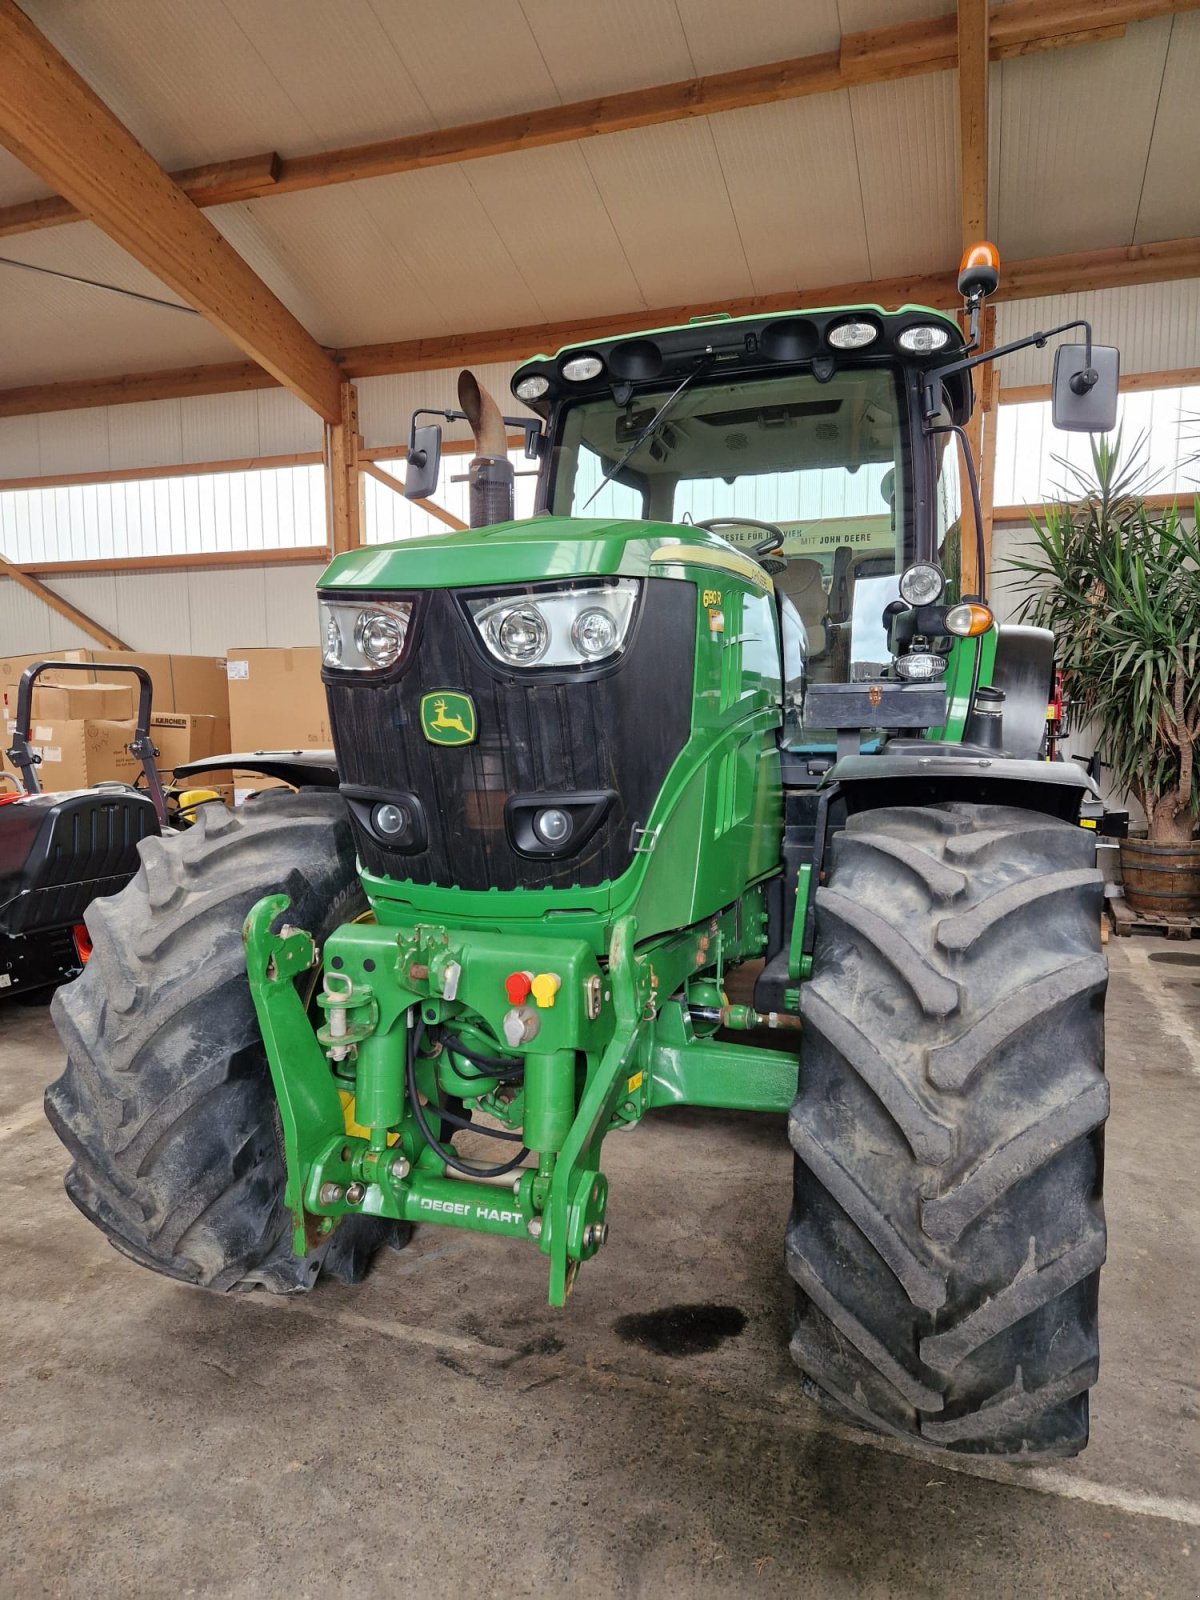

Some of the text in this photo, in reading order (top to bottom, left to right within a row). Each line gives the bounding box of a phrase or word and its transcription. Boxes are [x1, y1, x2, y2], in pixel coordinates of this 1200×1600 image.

[748, 531, 763, 540] FÜR
[801, 533, 871, 545] MIT JOHN DEERE
